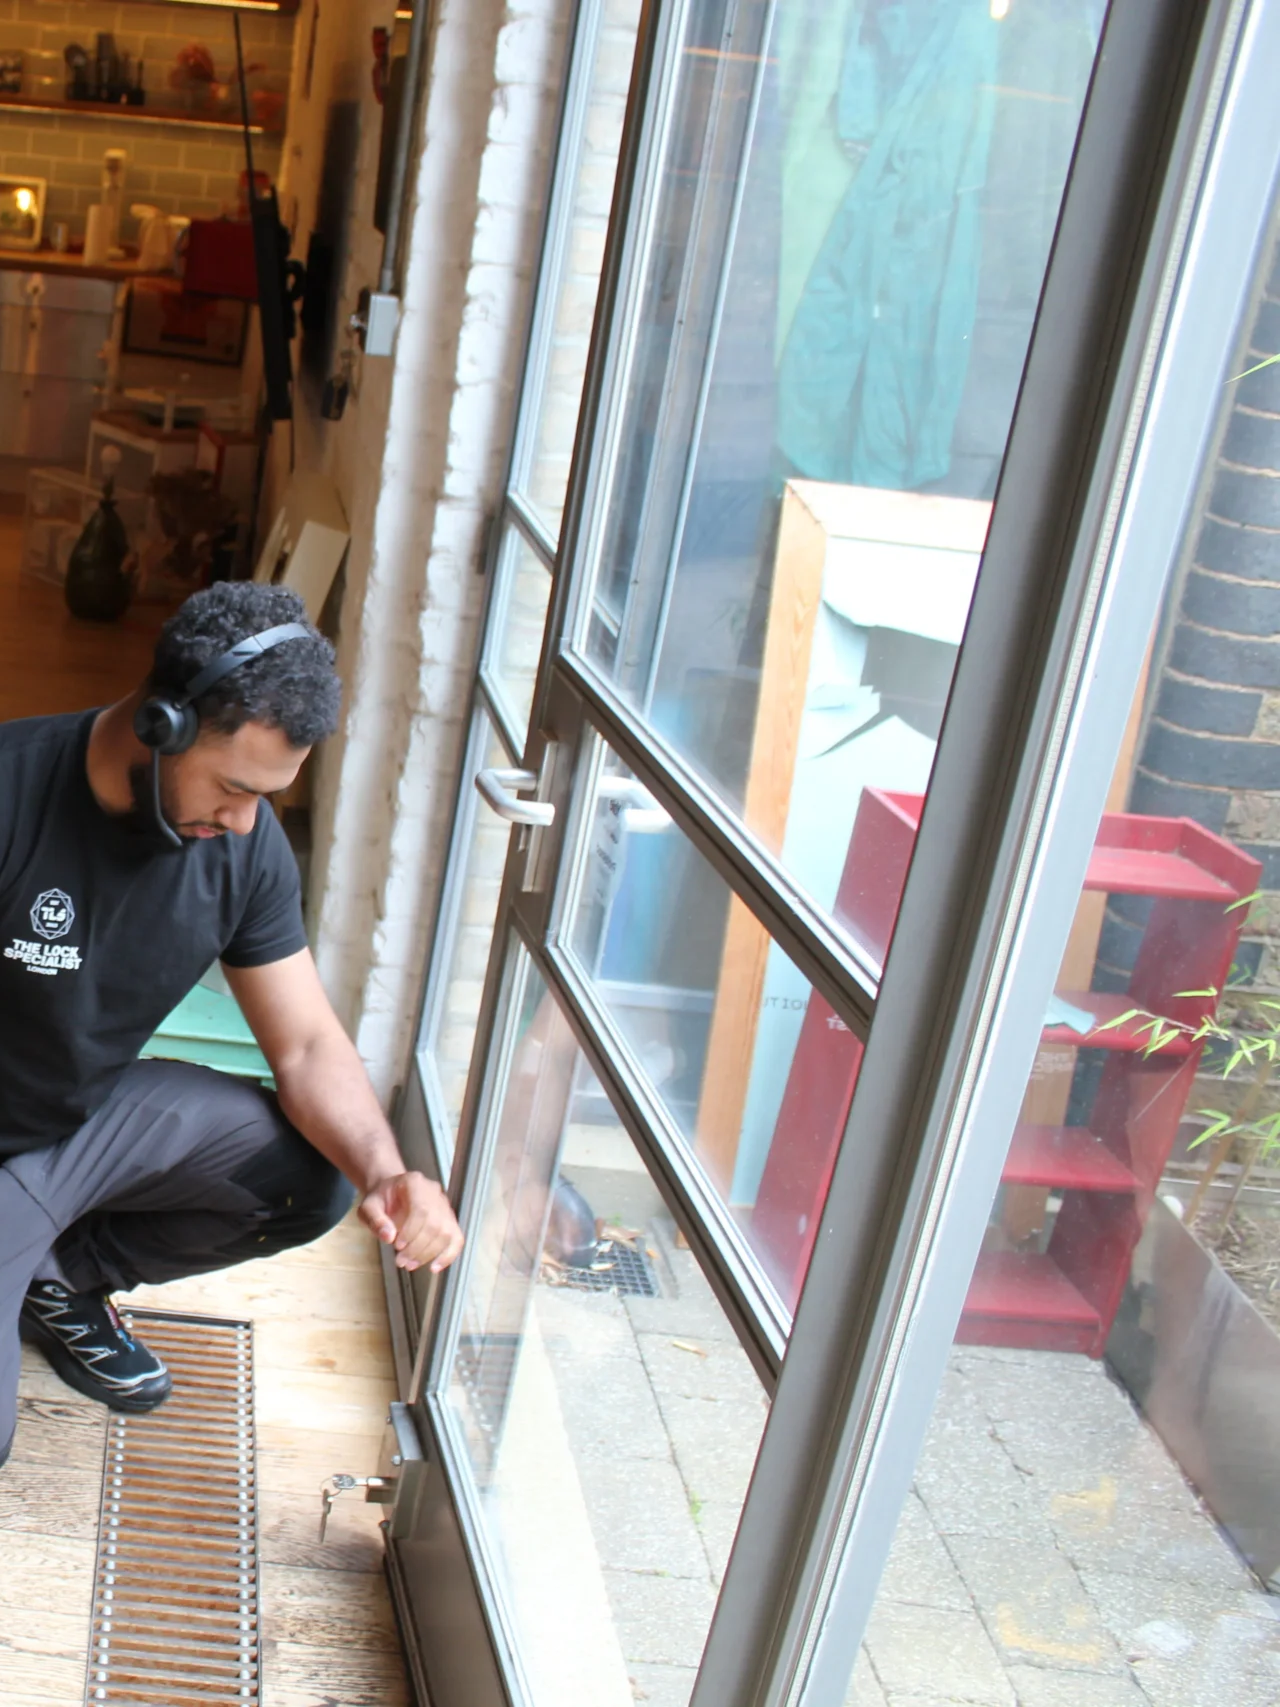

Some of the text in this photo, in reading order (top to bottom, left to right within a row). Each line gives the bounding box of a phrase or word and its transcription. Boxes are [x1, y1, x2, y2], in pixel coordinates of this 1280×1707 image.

[40, 906, 67, 922] TLS
[3, 947, 83, 970] SPECIALIST
[12, 938, 79, 959] THE LOCK
